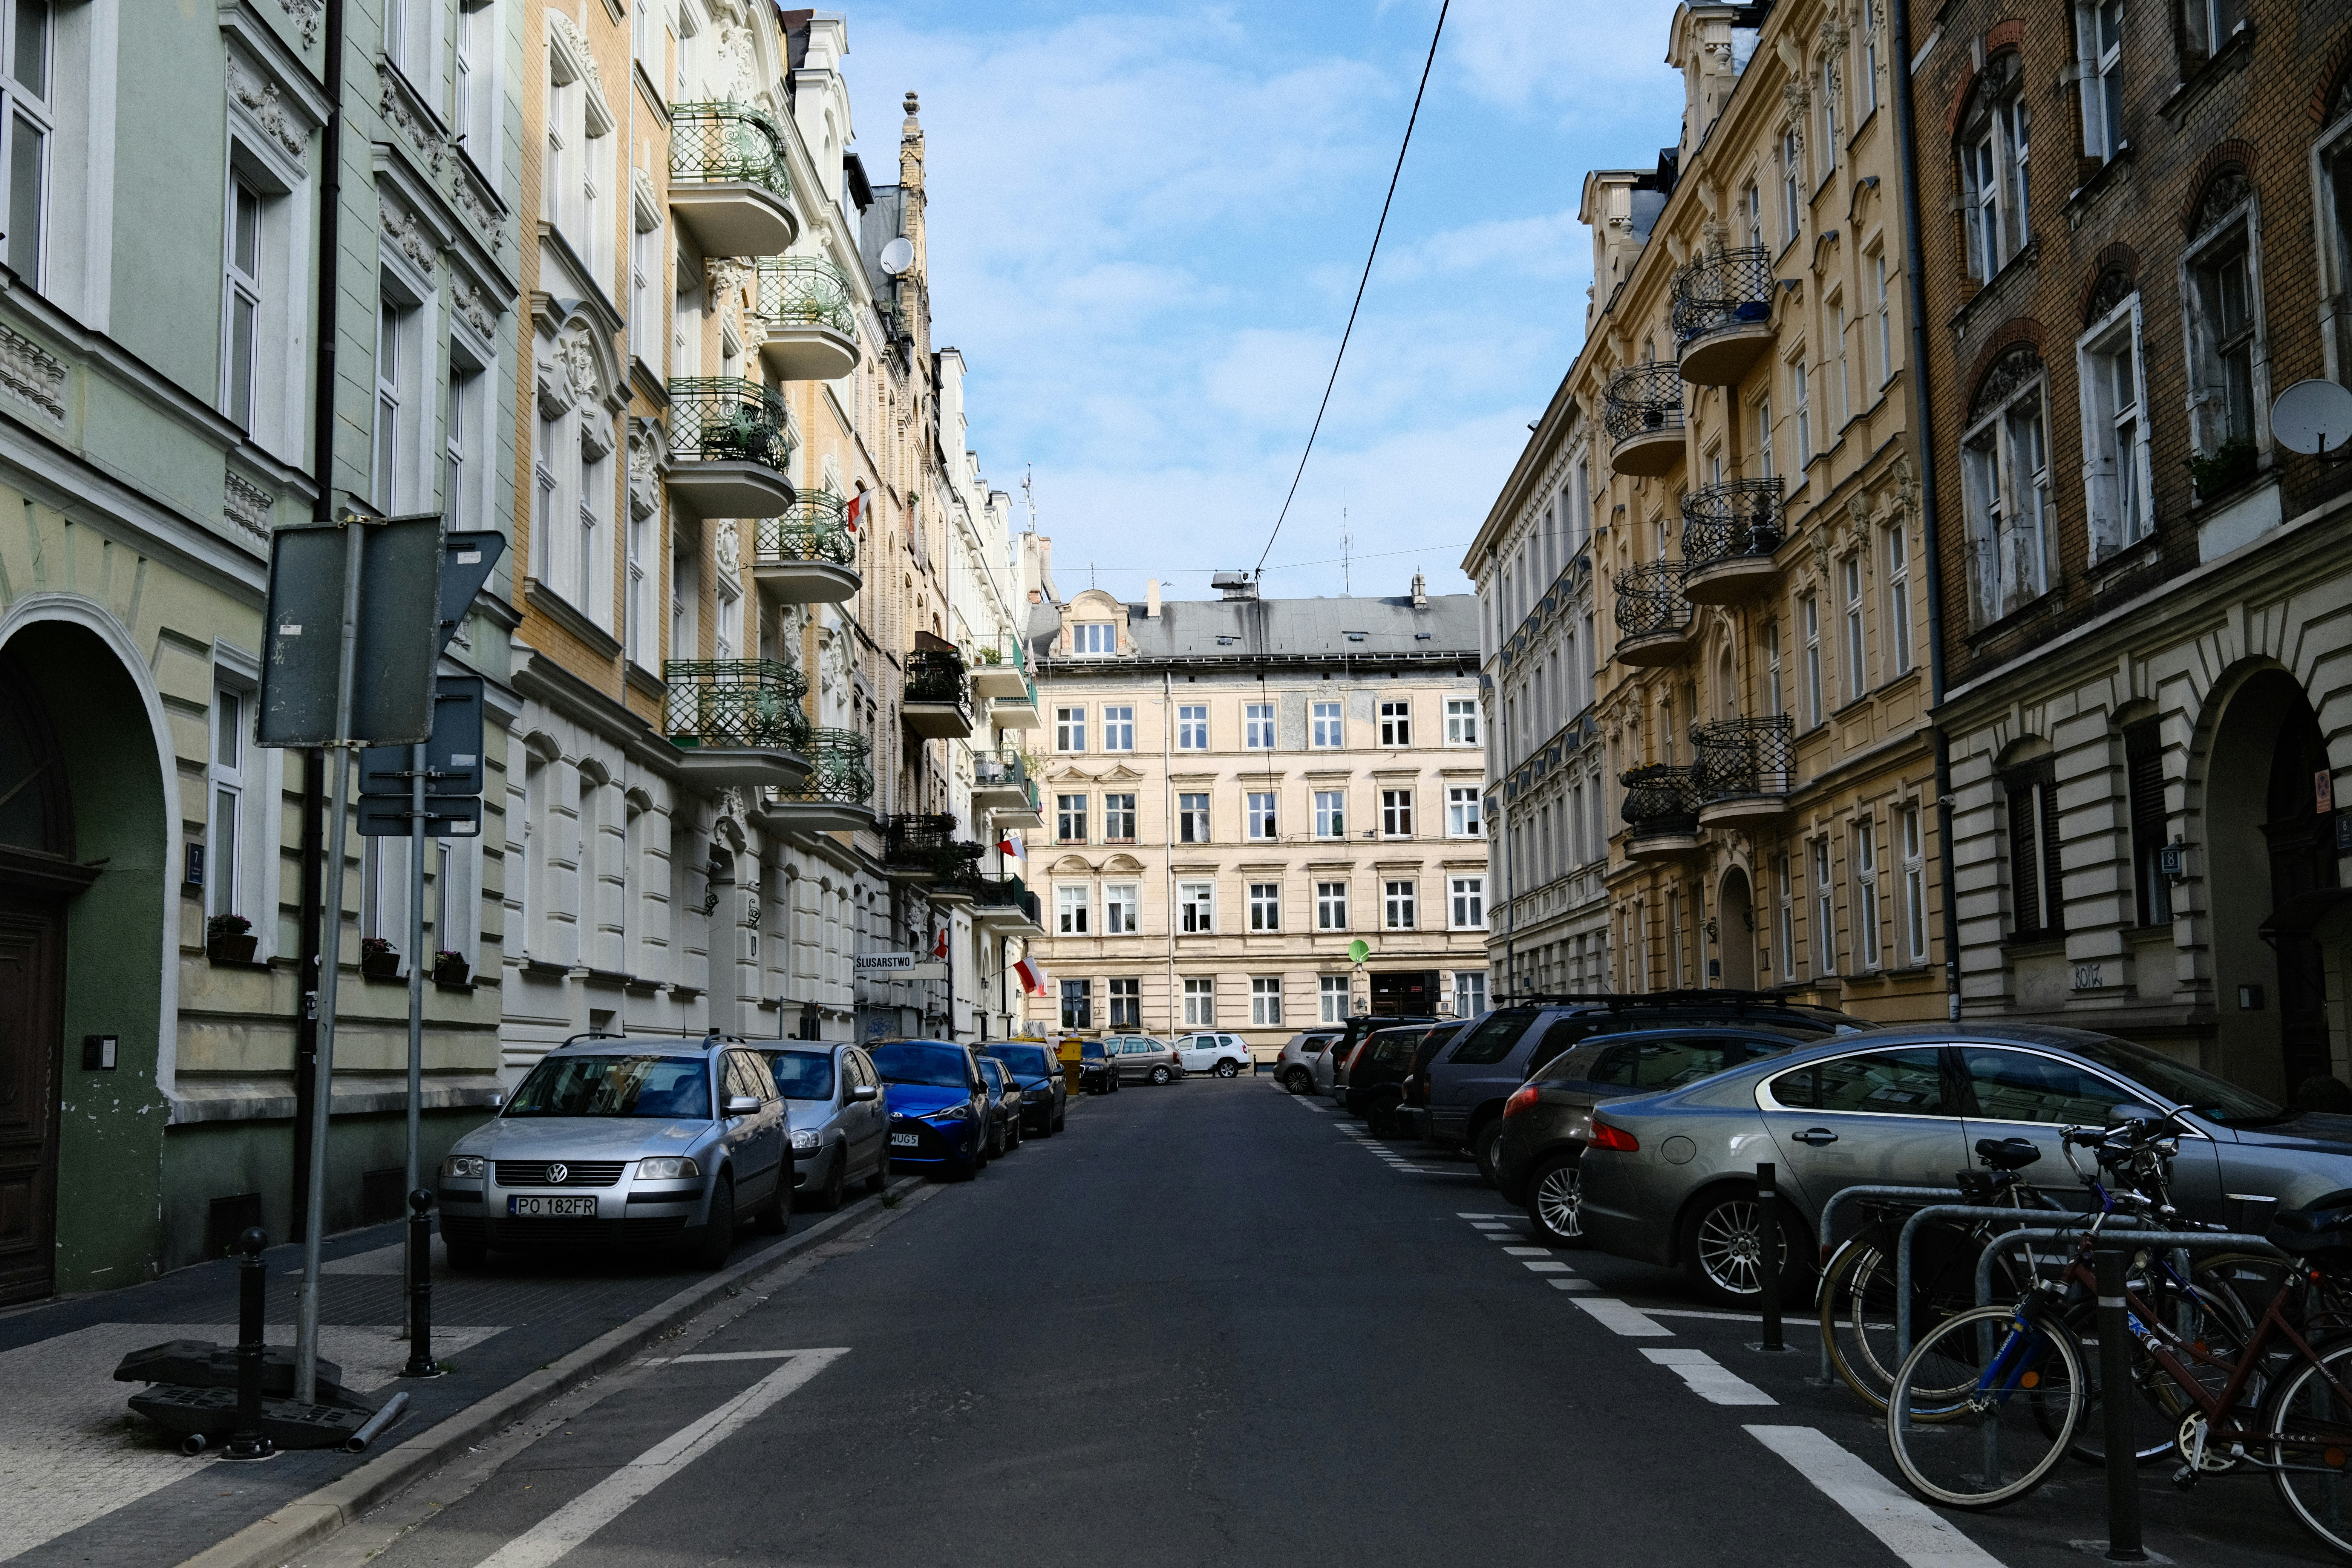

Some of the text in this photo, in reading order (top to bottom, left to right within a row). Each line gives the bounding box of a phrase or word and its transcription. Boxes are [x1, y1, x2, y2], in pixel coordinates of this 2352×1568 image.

[2343, 820, 2347, 831] 8
[2167, 852, 2174, 865] 8
[856, 956, 910, 968] ŚLUSARSTWO
[519, 1199, 593, 1213] PO 182FR
